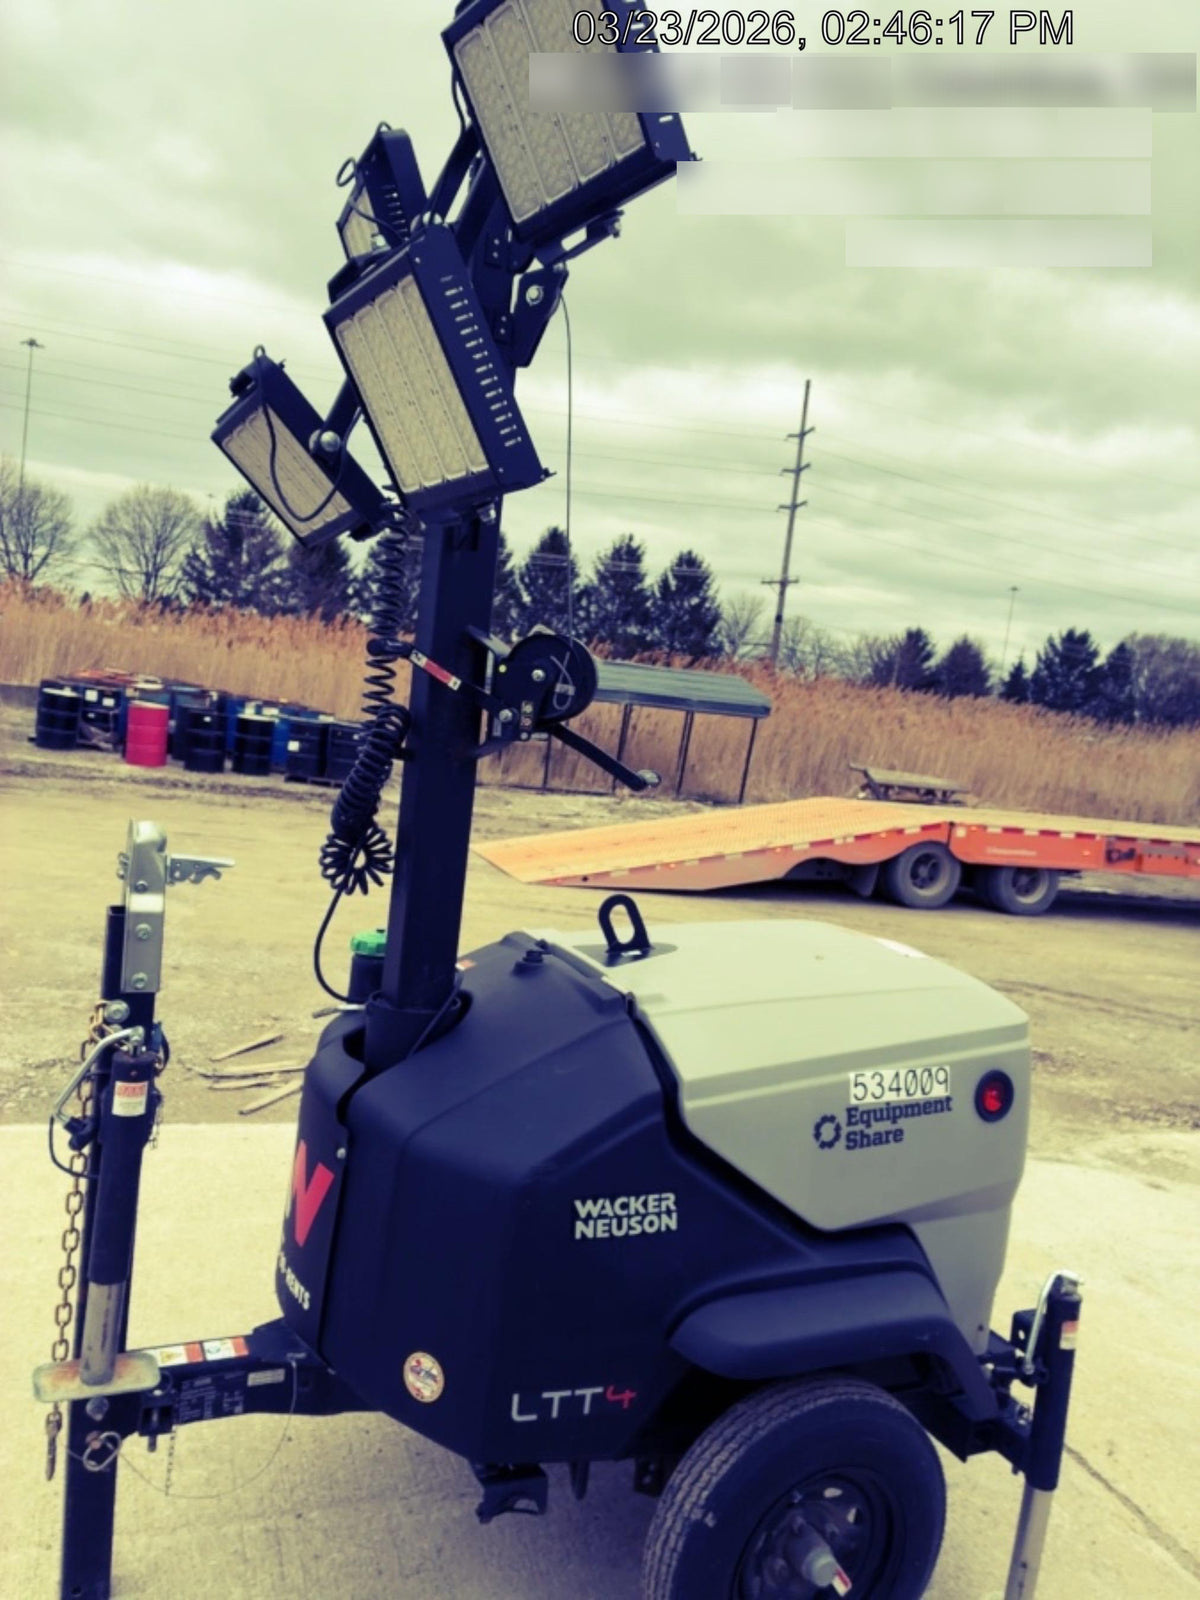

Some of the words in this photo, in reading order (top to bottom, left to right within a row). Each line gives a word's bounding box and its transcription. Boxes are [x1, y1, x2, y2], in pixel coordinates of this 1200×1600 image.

[852, 1067, 950, 1101] 534009
[845, 1096, 953, 1128] Equipment
[845, 1127, 904, 1151] Share
[574, 1193, 677, 1218] WACKER
[574, 1212, 678, 1239] NEUSON
[510, 1385, 637, 1422] LTT4
